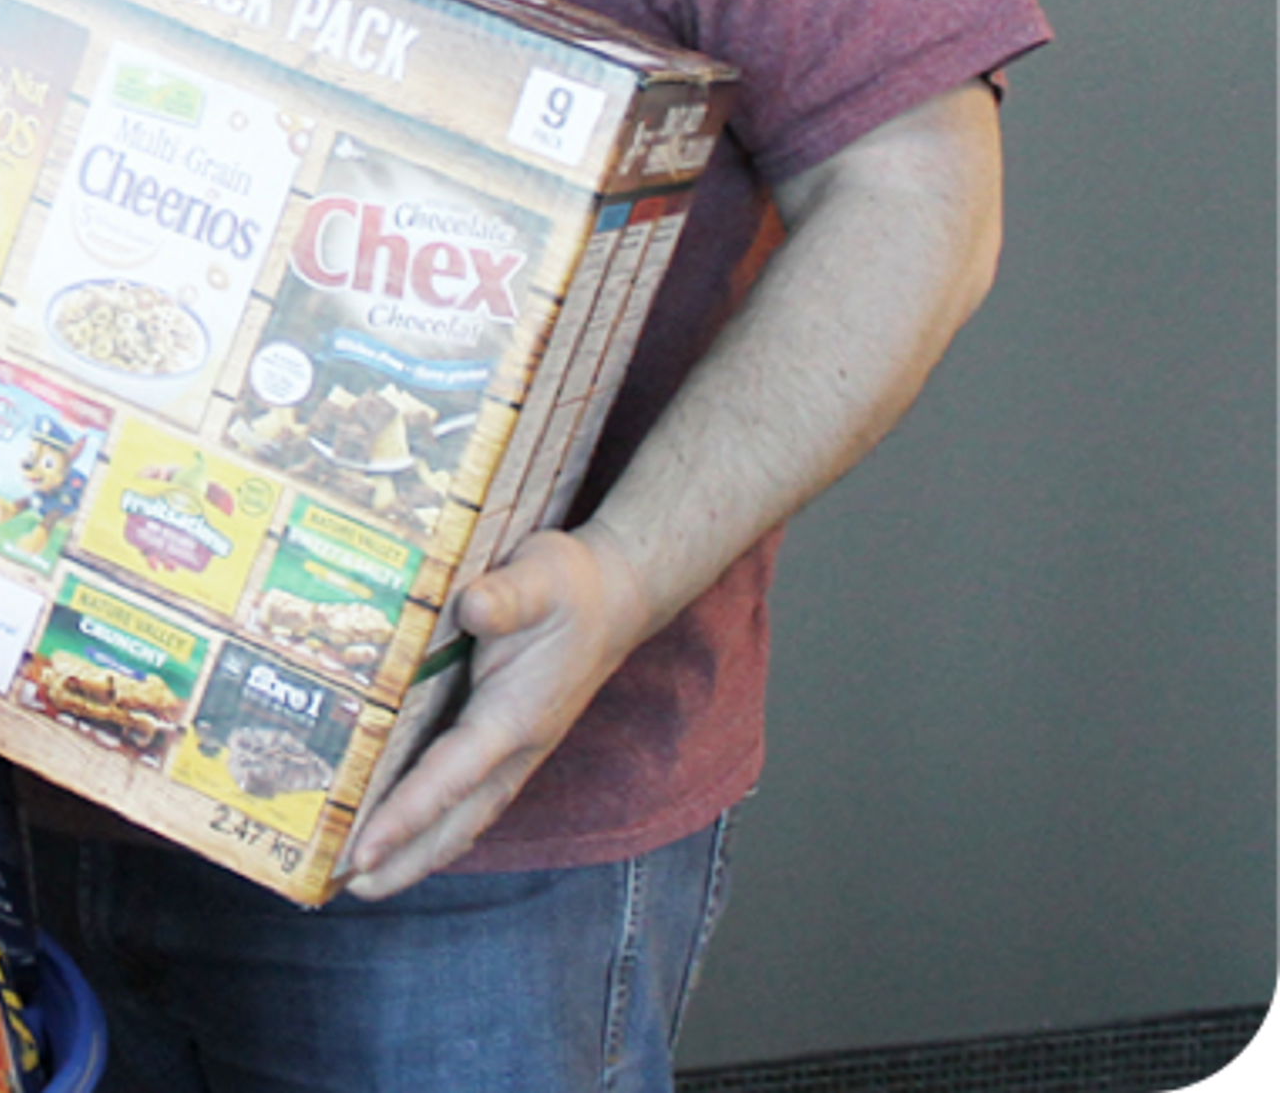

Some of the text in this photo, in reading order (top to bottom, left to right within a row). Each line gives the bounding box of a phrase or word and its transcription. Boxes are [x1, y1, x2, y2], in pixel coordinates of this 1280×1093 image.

[541, 86, 574, 130] 9
[114, 114, 253, 197] Multi Grain
[78, 143, 261, 260] Cheerios
[393, 201, 514, 244] Chocolate
[291, 196, 523, 319] Chex
[367, 304, 482, 342] Chocolat
[209, 803, 305, 875] 2.47 kg
